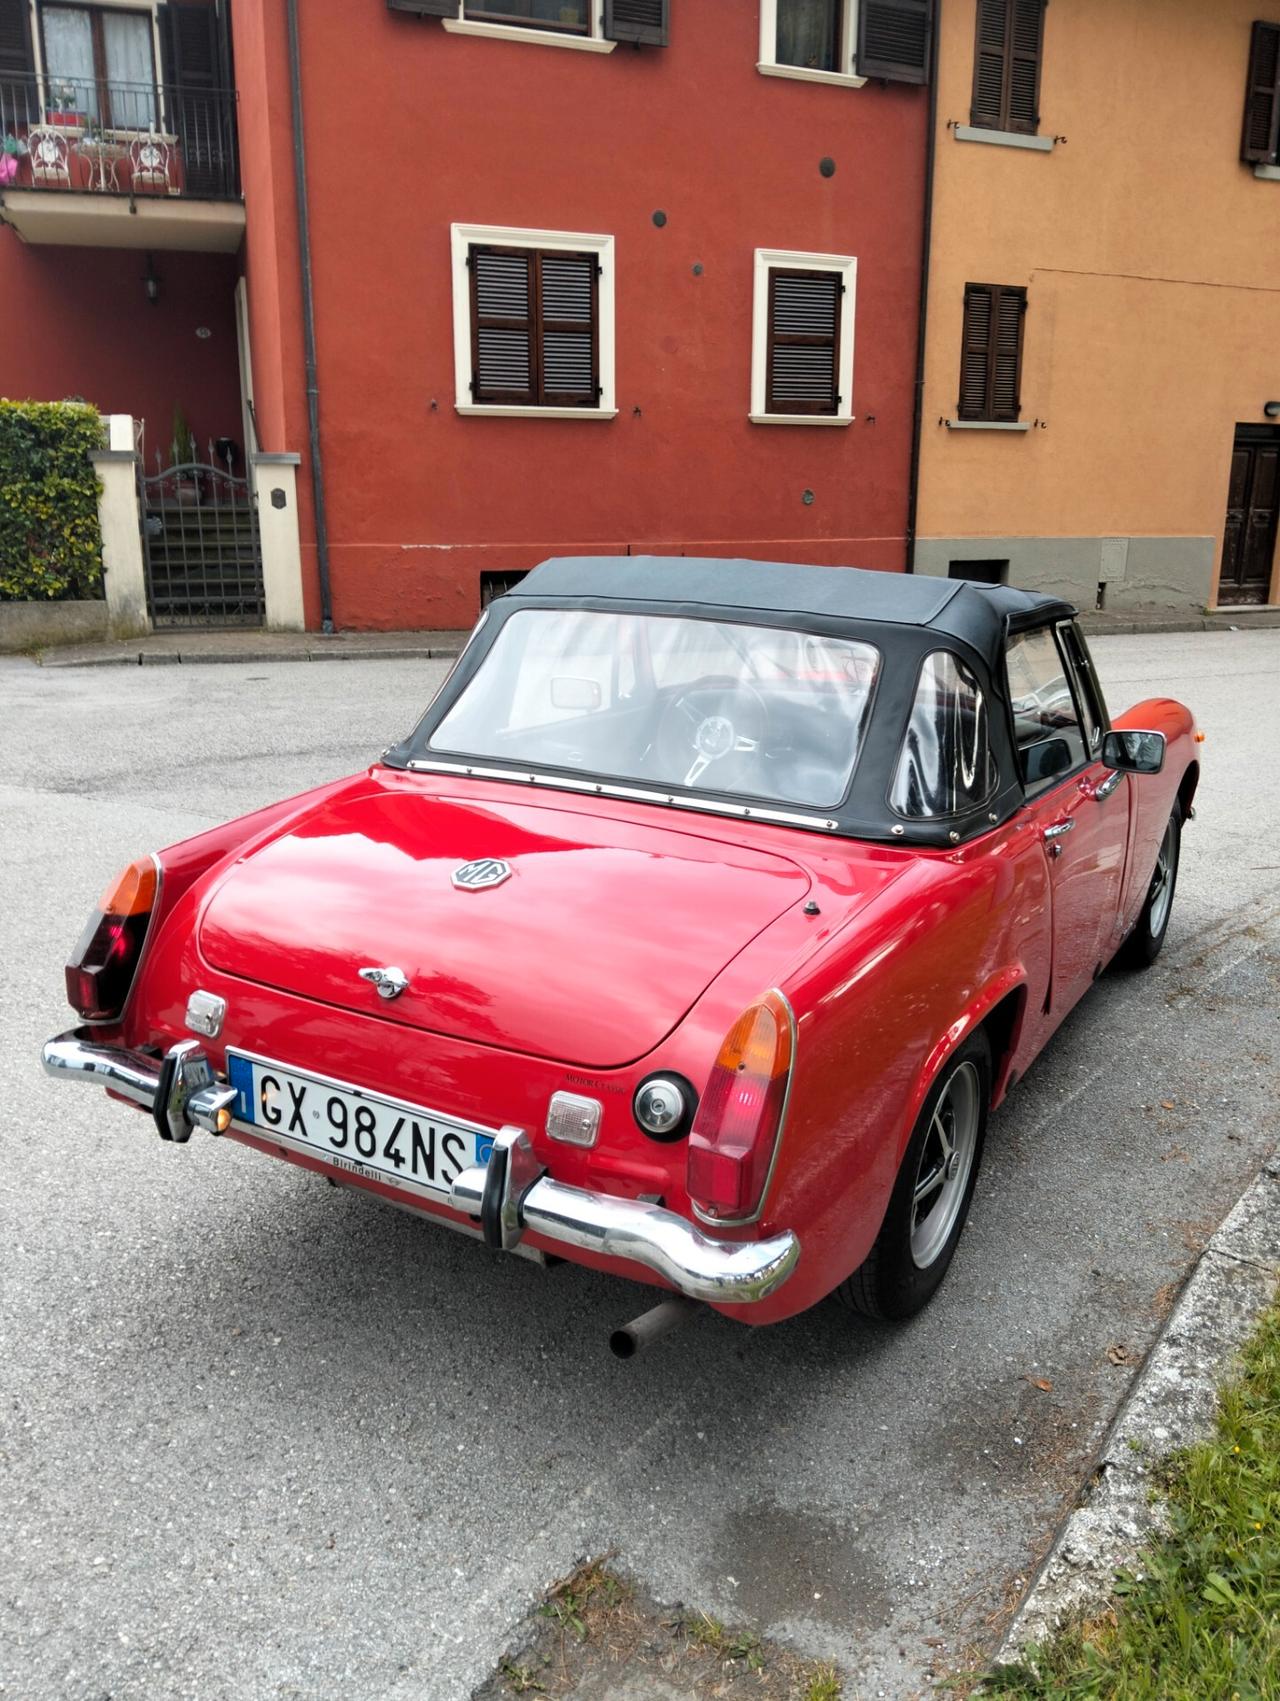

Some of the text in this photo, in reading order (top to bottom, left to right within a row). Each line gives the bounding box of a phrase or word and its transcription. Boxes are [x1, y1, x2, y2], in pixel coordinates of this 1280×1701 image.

[458, 861, 503, 884] MG
[260, 1074, 467, 1187] GX 984NS
[333, 1156, 382, 1181] Birindelli
